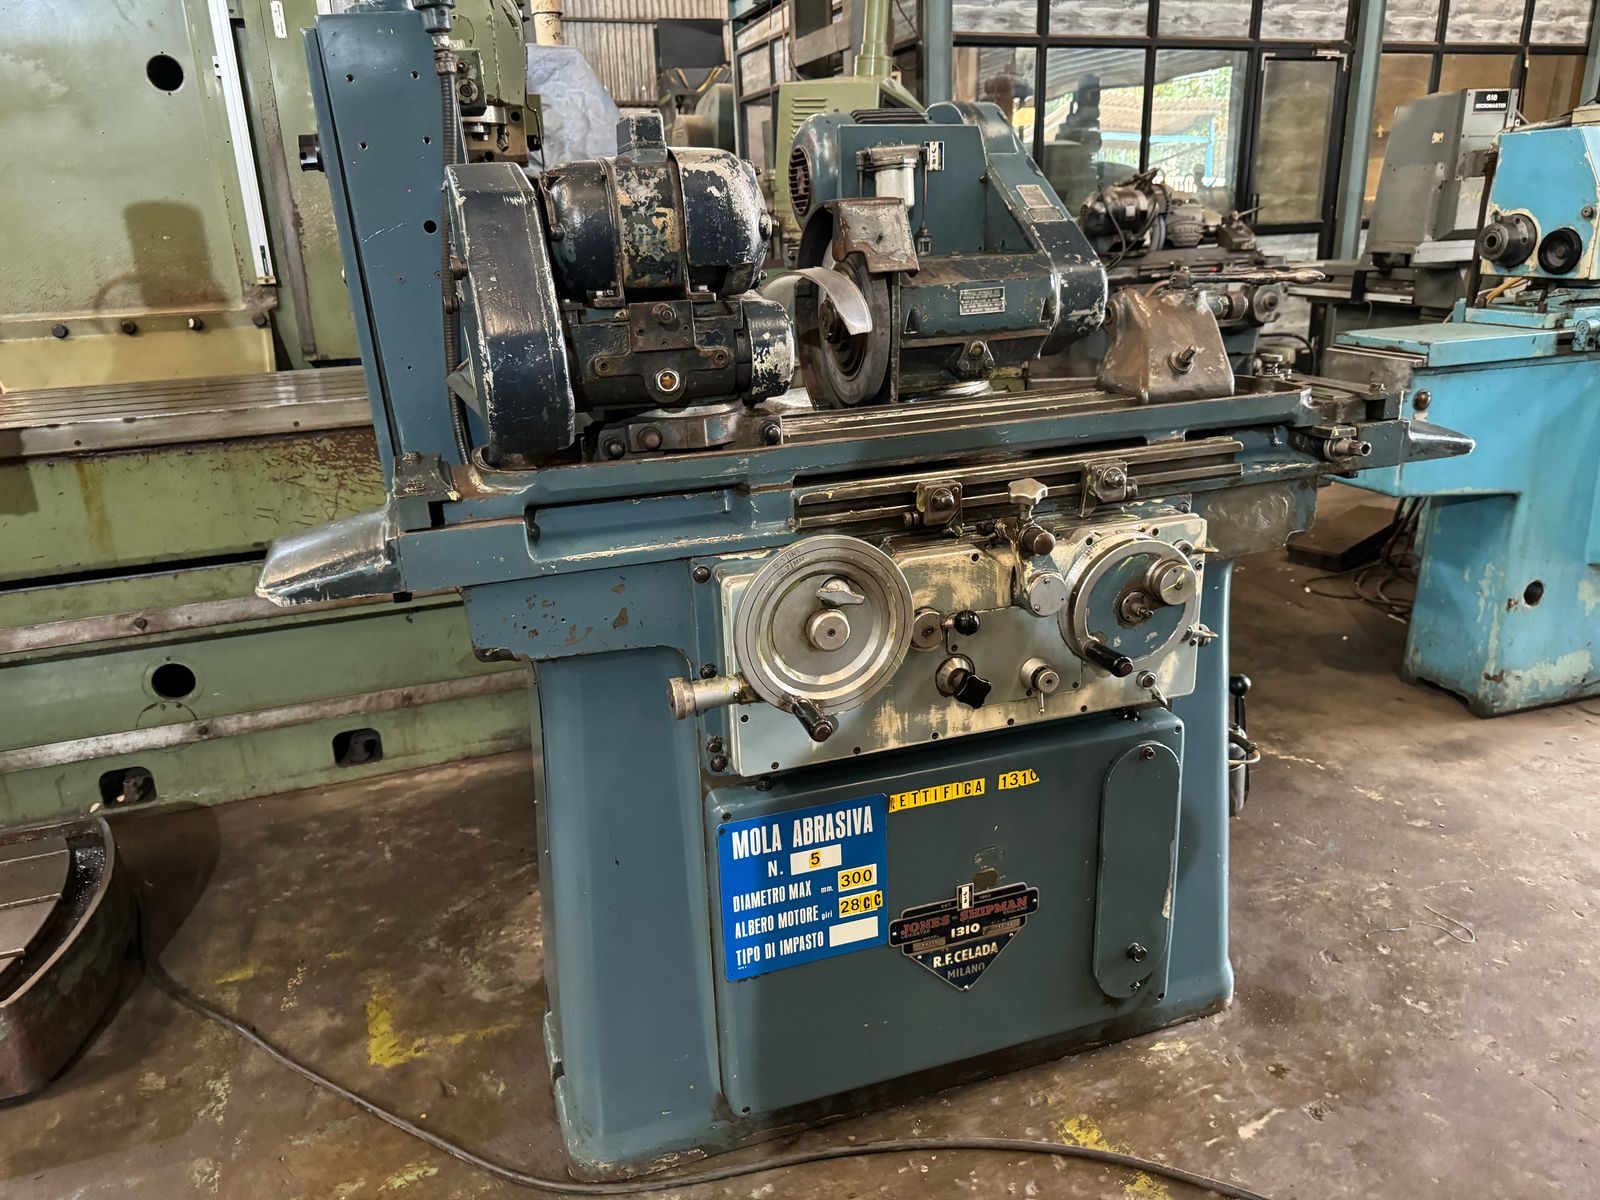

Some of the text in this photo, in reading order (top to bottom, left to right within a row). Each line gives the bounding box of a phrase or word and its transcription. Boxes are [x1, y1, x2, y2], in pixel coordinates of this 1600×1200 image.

[731, 805, 873, 860] MOLA ABRASIVA
[767, 852, 820, 878] N. 5
[732, 886, 786, 913] DIAMETRO
[788, 880, 812, 900] MAX
[841, 869, 872, 887] 300
[735, 915, 774, 939] ALBERO
[778, 905, 819, 929] MOTORE
[821, 910, 833, 920] giri
[900, 914, 951, 936] JONES
[959, 895, 1028, 921] SHIPMAN
[951, 922, 981, 939] 1310
[735, 931, 824, 967] TIPO DI IMPASTO
[947, 962, 986, 980] MILANO
